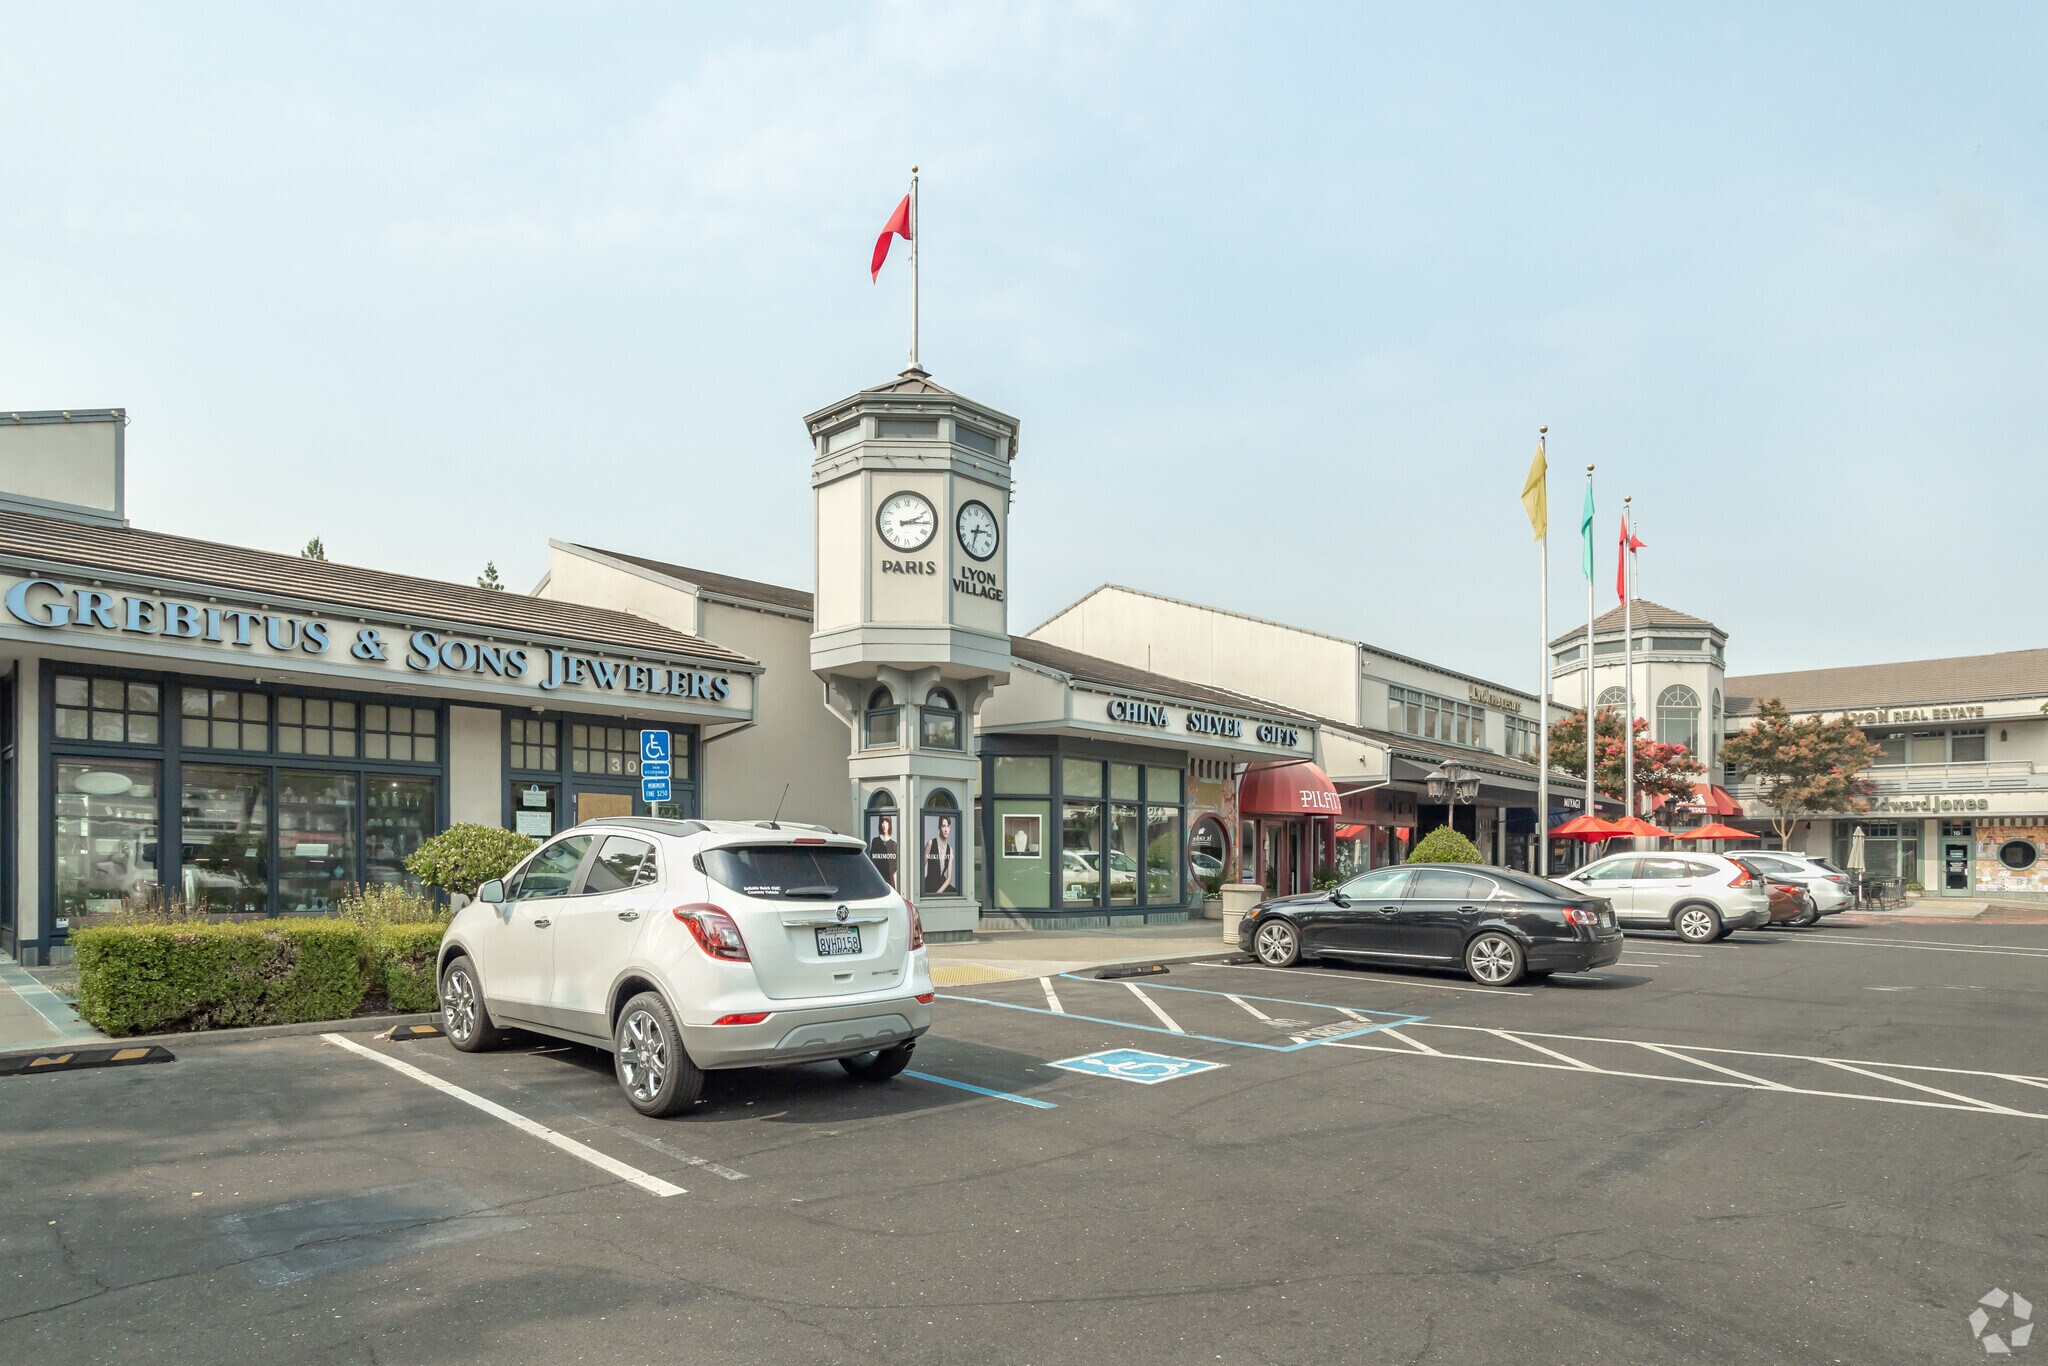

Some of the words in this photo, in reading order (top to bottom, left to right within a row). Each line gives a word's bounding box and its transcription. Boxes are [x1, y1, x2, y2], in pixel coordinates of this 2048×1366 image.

[882, 560, 937, 576] PARIS
[961, 566, 996, 586] LYON
[952, 578, 1004, 602] VILLAGE
[5, 578, 330, 654] GREBITUS
[350, 628, 389, 662] &
[406, 630, 530, 679] SONS
[538, 648, 731, 702] JEWELERS
[1106, 700, 1171, 727] CHINA
[1186, 712, 1243, 738] SILVER
[1256, 724, 1299, 747] GIFTS
[1843, 709, 1889, 725] YON
[1893, 709, 1929, 722] REAL
[1932, 706, 1985, 720] ESTATE
[645, 790, 655, 798] FINE
[1932, 796, 1989, 813] Jones
[820, 936, 859, 951] 8VHD158
